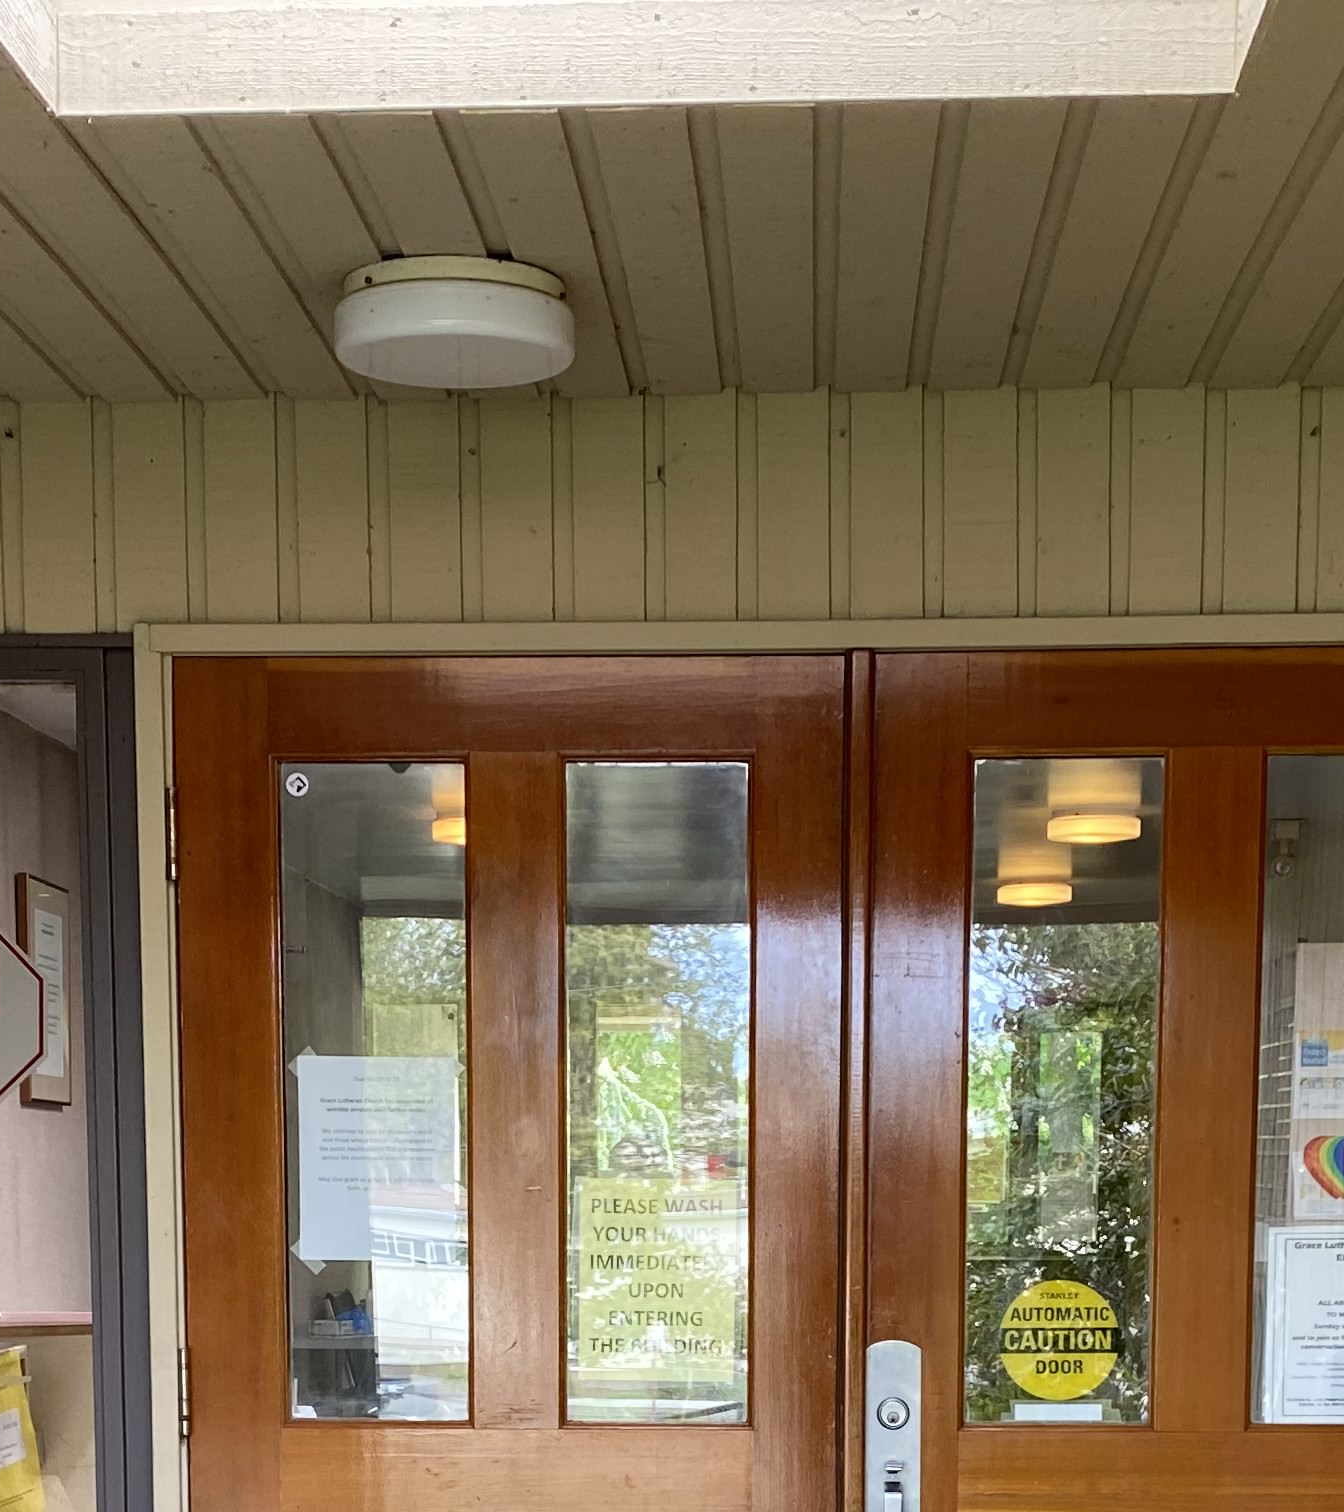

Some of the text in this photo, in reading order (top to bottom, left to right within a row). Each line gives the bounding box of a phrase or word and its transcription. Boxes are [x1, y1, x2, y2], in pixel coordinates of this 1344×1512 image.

[591, 1198, 722, 1214] PLEASE WASH
[593, 1227, 647, 1242] YOUR
[629, 1282, 684, 1298] UPON
[1040, 1292, 1079, 1300] STANLEY
[609, 1311, 703, 1327] ENTERING
[1010, 1307, 1110, 1321] AUTOMATIC
[1004, 1329, 1112, 1350] CAUTION
[1036, 1360, 1084, 1374] DOOR
